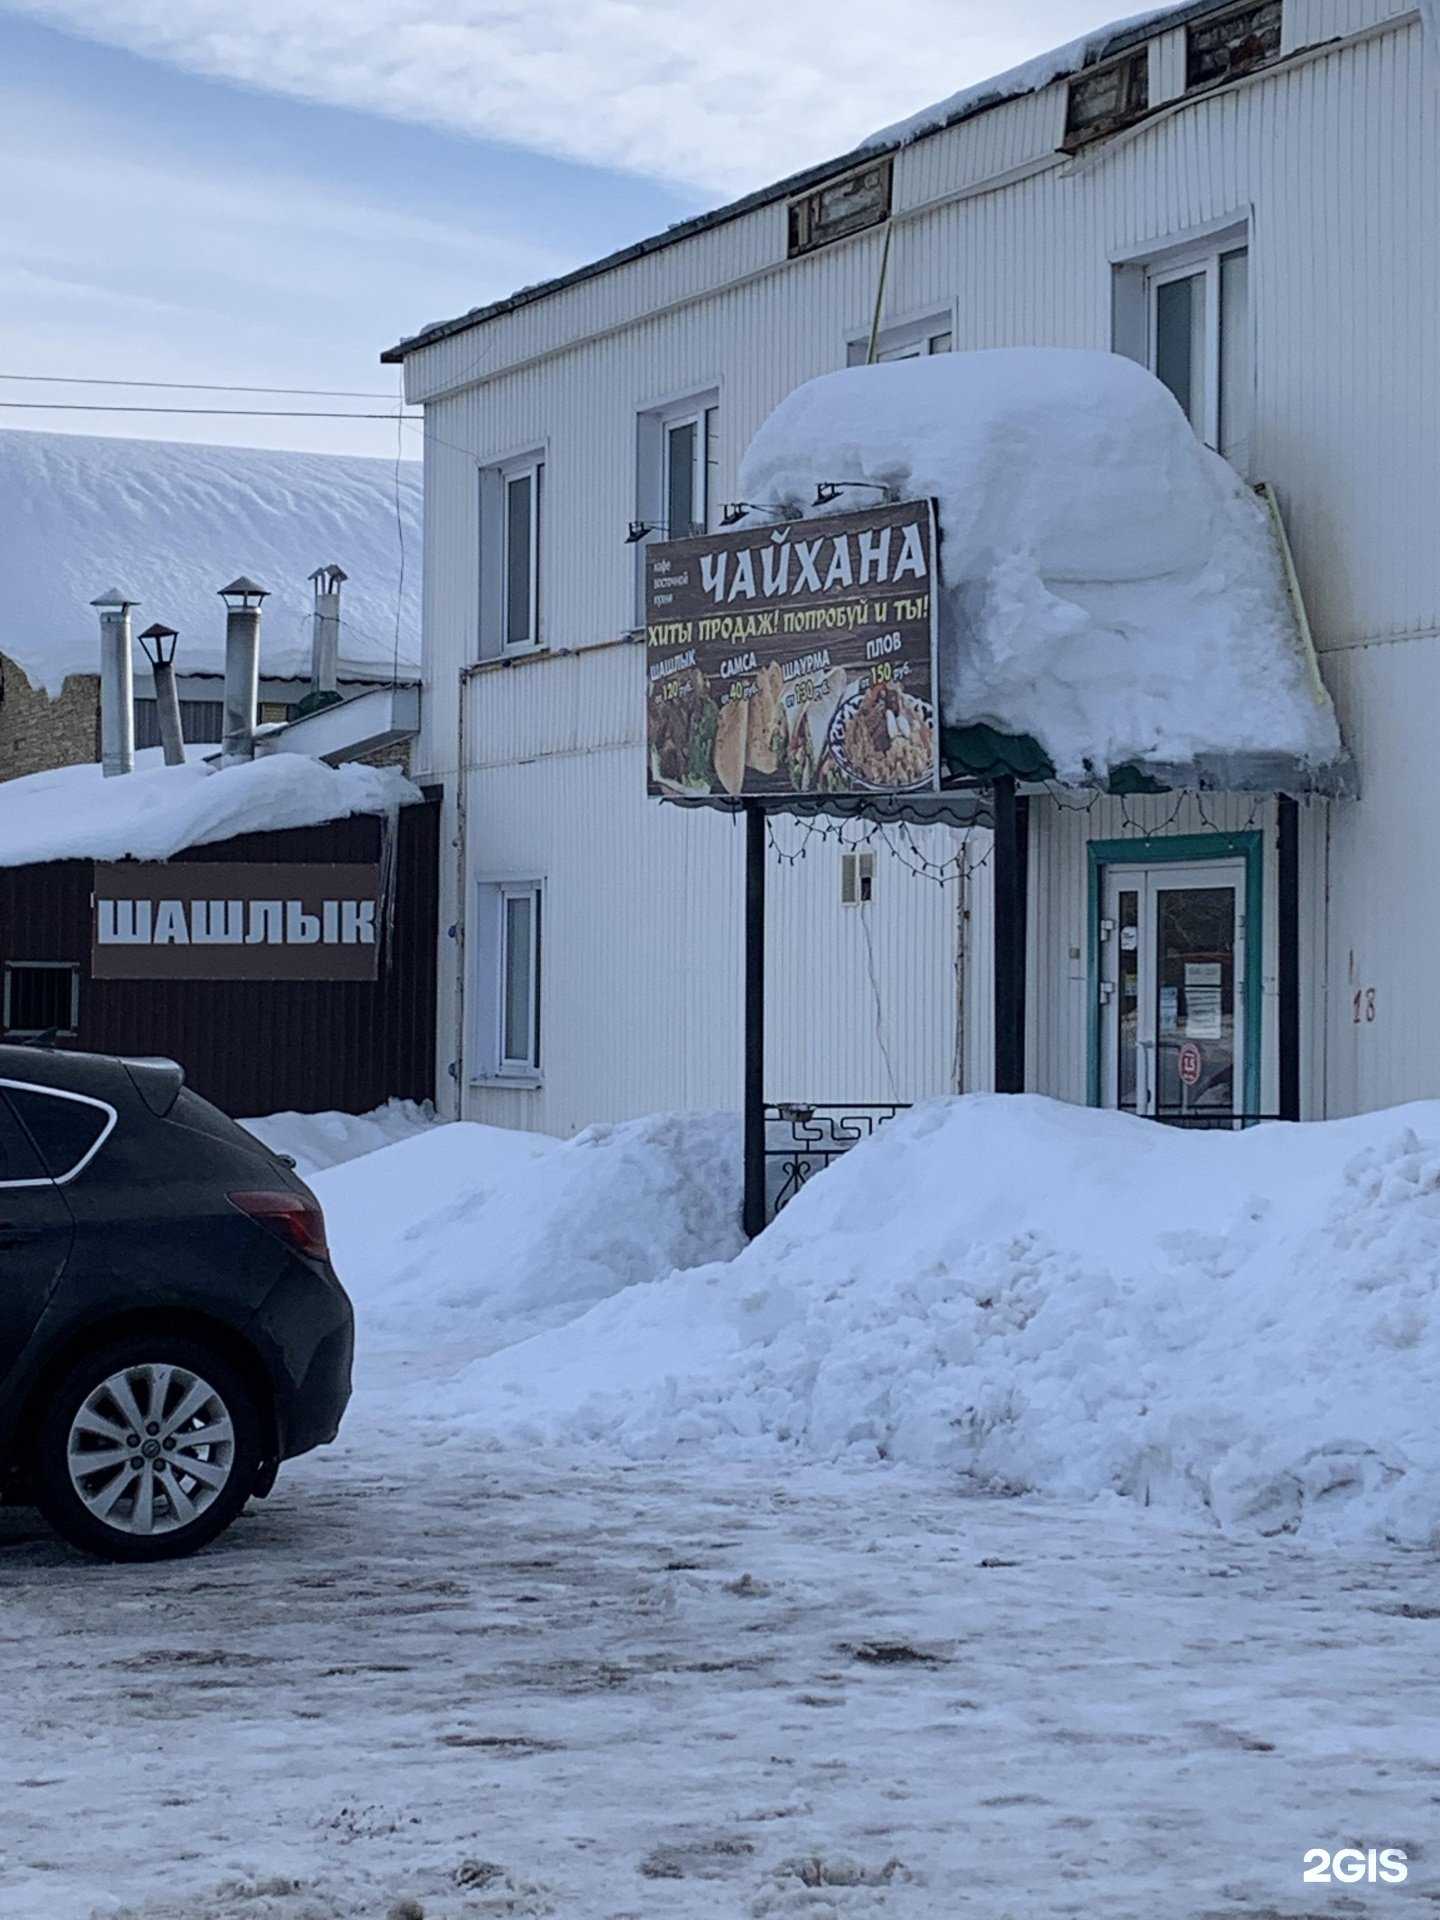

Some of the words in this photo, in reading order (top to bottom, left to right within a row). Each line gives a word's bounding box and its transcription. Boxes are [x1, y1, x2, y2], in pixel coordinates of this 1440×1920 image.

[700, 523, 928, 604] ЧАЙХАНА
[647, 621, 693, 648] ХИТЫ
[698, 609, 780, 645] ПРОДАЖ!
[783, 598, 869, 633] ПОПРОБУЙ
[874, 601, 888, 623] И
[893, 594, 929, 622] ТЫ!
[866, 631, 902, 660] ПЛОВ
[649, 648, 697, 681] ШАШЛЫК
[720, 651, 758, 679] САМСА
[782, 649, 831, 681] ШАУРМА
[871, 661, 893, 685] 150
[98, 899, 376, 945] ШАШЛЫК
